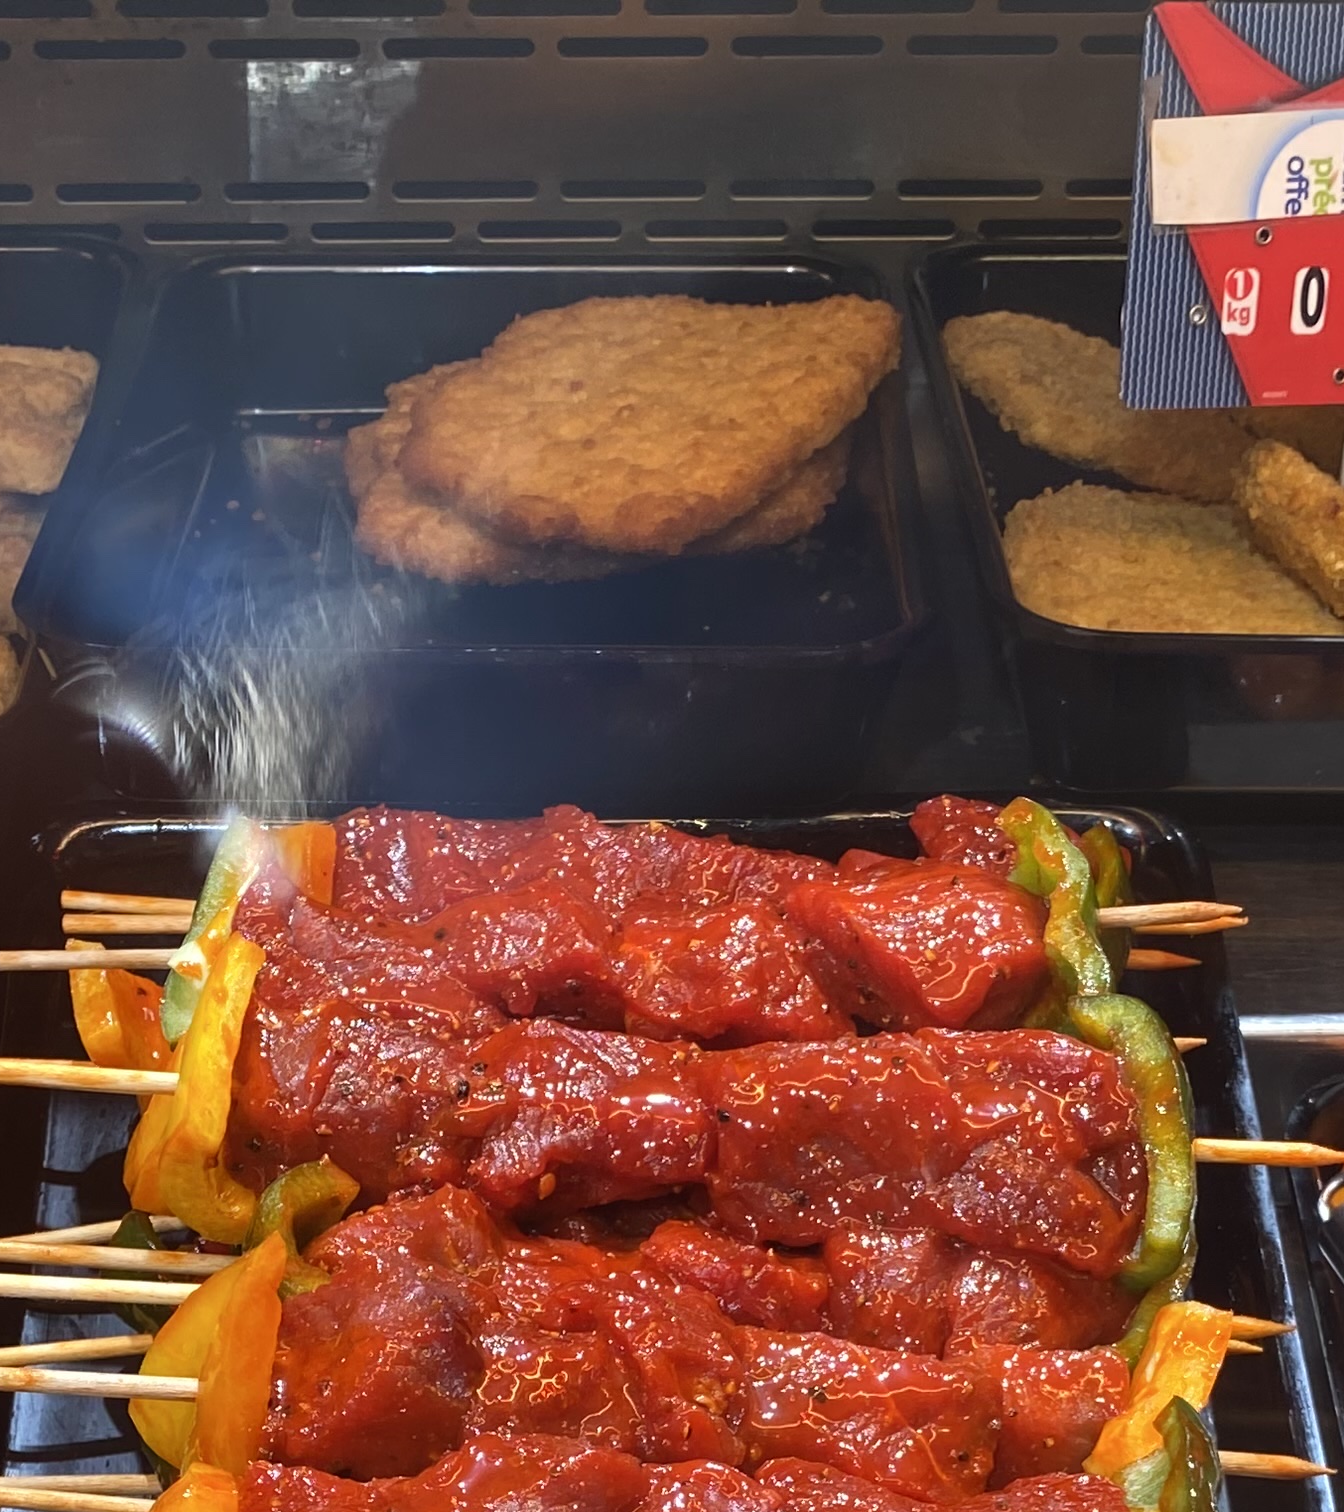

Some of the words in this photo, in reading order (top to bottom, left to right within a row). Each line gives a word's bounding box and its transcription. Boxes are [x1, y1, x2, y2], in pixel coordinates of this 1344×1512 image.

[1285, 155, 1310, 215] offe
[1233, 273, 1245, 298] 1
[1226, 303, 1251, 326] kg
